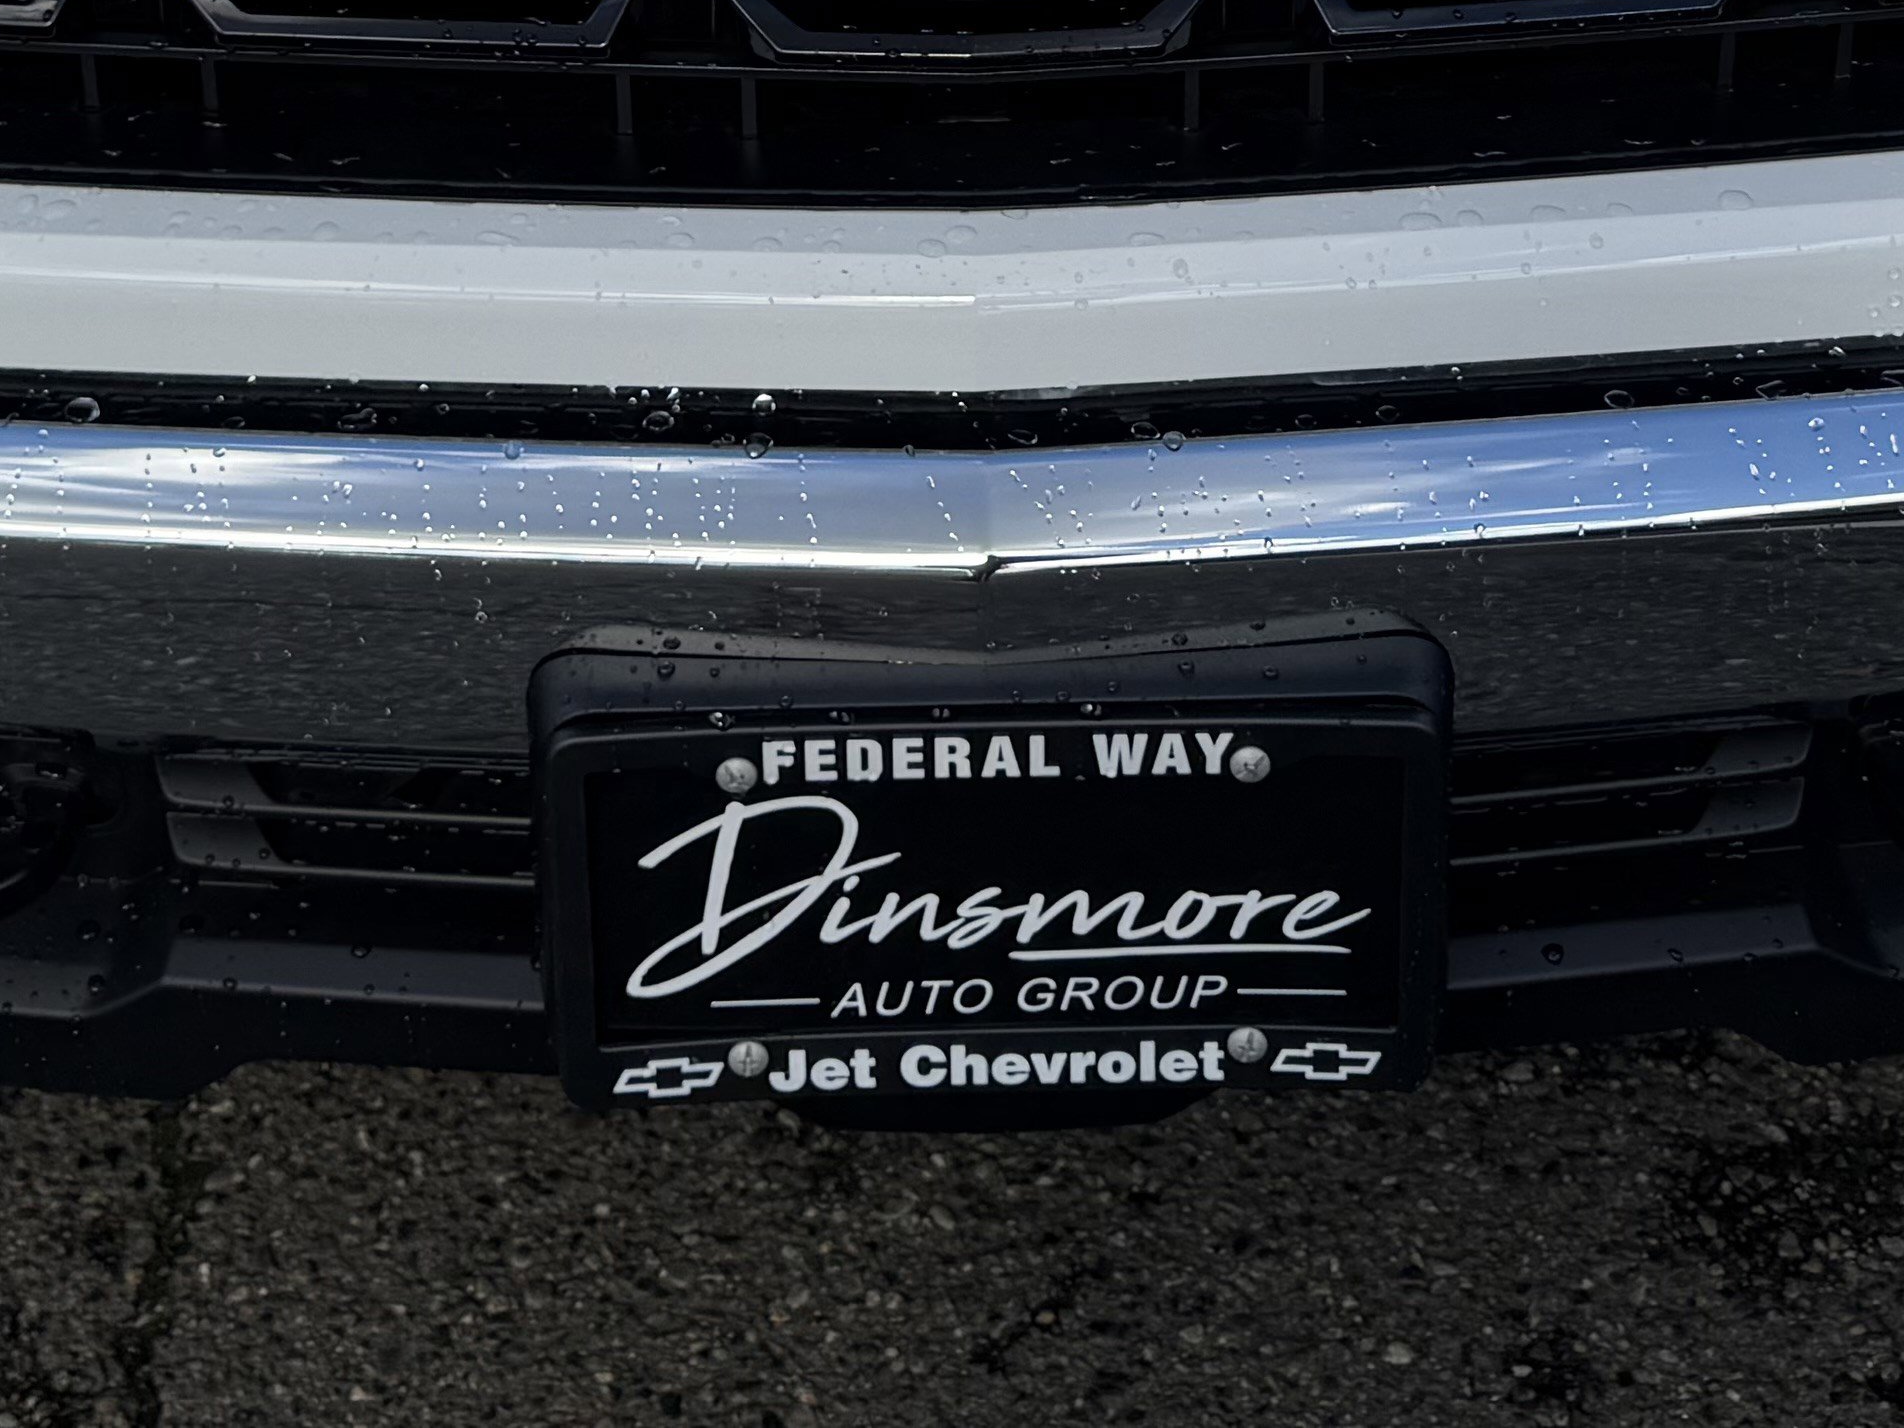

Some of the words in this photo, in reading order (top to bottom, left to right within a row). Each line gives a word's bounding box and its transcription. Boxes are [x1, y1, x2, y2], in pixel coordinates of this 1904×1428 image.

[761, 734, 1062, 785] FEDERAL
[1092, 732, 1234, 778] WAY
[626, 795, 1372, 999] Dinsmore
[830, 978, 994, 1019] AUTO
[1016, 975, 1228, 1012] GROUP
[768, 1048, 877, 1092] Jet
[900, 1040, 1225, 1088] Chevrolet
